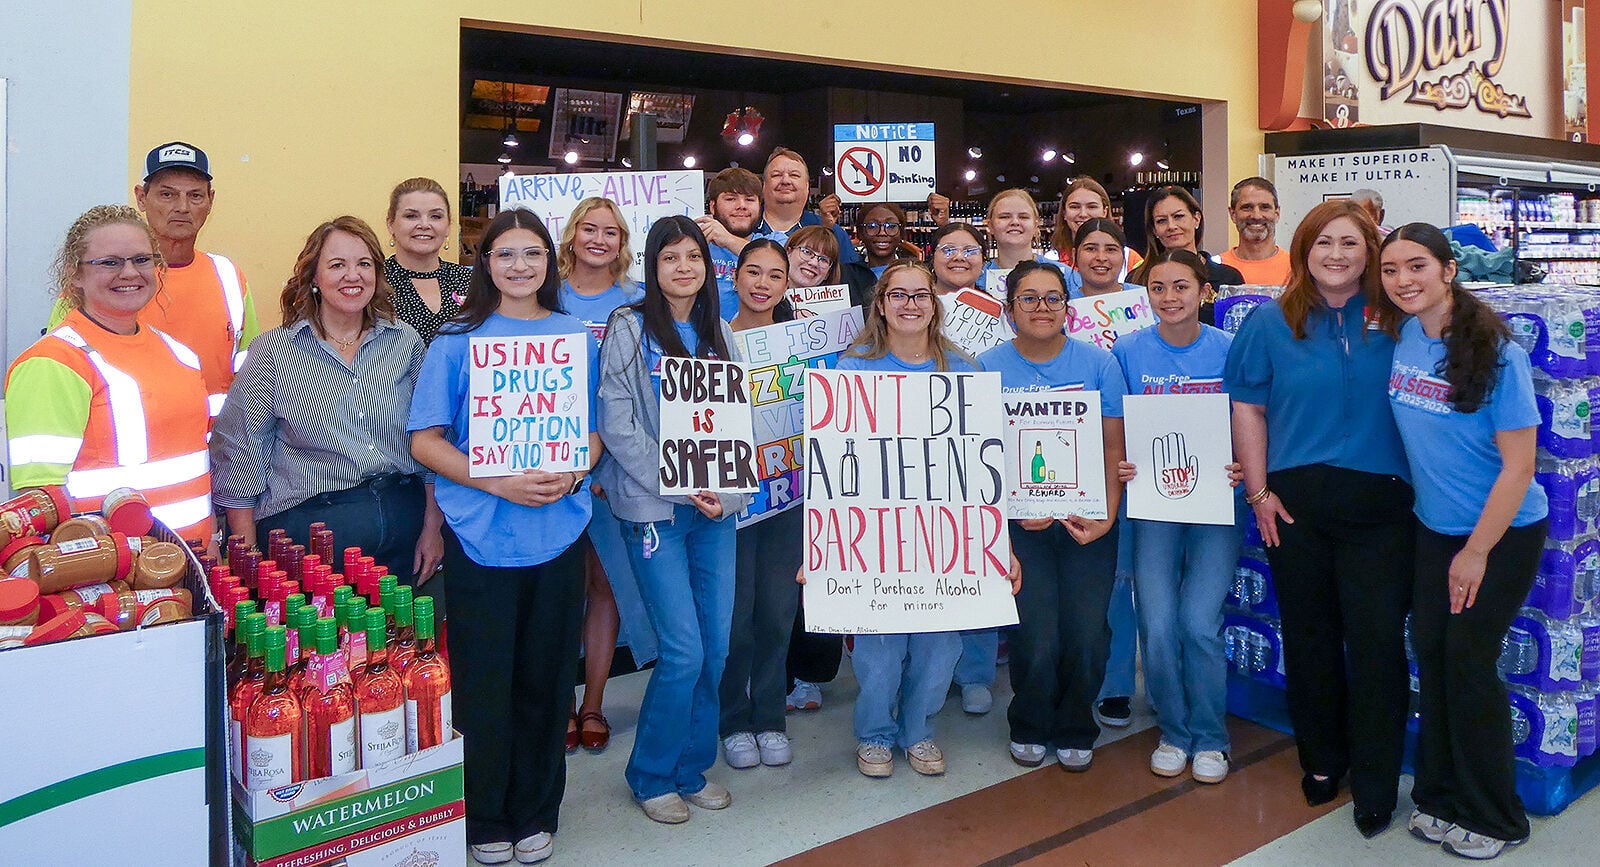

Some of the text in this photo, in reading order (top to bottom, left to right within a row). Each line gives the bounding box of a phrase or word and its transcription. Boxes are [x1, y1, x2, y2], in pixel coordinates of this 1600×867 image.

[1365, 0, 1510, 100] Dairy
[1175, 106, 1197, 116] Texas
[898, 145, 922, 163] NO
[1288, 152, 1436, 170] MAKE IT SUPERIOR.
[1300, 169, 1421, 183] MAKE IT ULTRA.
[602, 174, 671, 207] ALIVE
[952, 300, 1000, 332] YOUR
[1094, 295, 1149, 328] Smart
[785, 319, 828, 356] IS
[838, 312, 861, 345] A
[492, 366, 573, 393] DRUGS
[661, 358, 748, 404] SOBER
[1141, 373, 1191, 386] Drug-Free
[473, 392, 557, 417] IS AN
[808, 372, 981, 437] DON'T BE
[1004, 401, 1088, 417] WANTED
[472, 444, 509, 465] SAY
[512, 443, 542, 469] NO
[545, 441, 570, 462] TO
[659, 439, 759, 489] SAFER
[807, 437, 1004, 506] A TEEN'S
[1162, 465, 1195, 484] STOP!
[1028, 489, 1066, 498] REWARD
[808, 504, 1010, 578] BARTENDER
[827, 577, 982, 596] Don't Purchase Alcohol
[869, 600, 944, 612] for minors
[263, 768, 285, 777] ROSA
[292, 779, 436, 836] WATERMELON
[350, 823, 406, 849] DELICIOUS
[407, 819, 417, 831] &
[419, 807, 454, 827] BUBBLY
